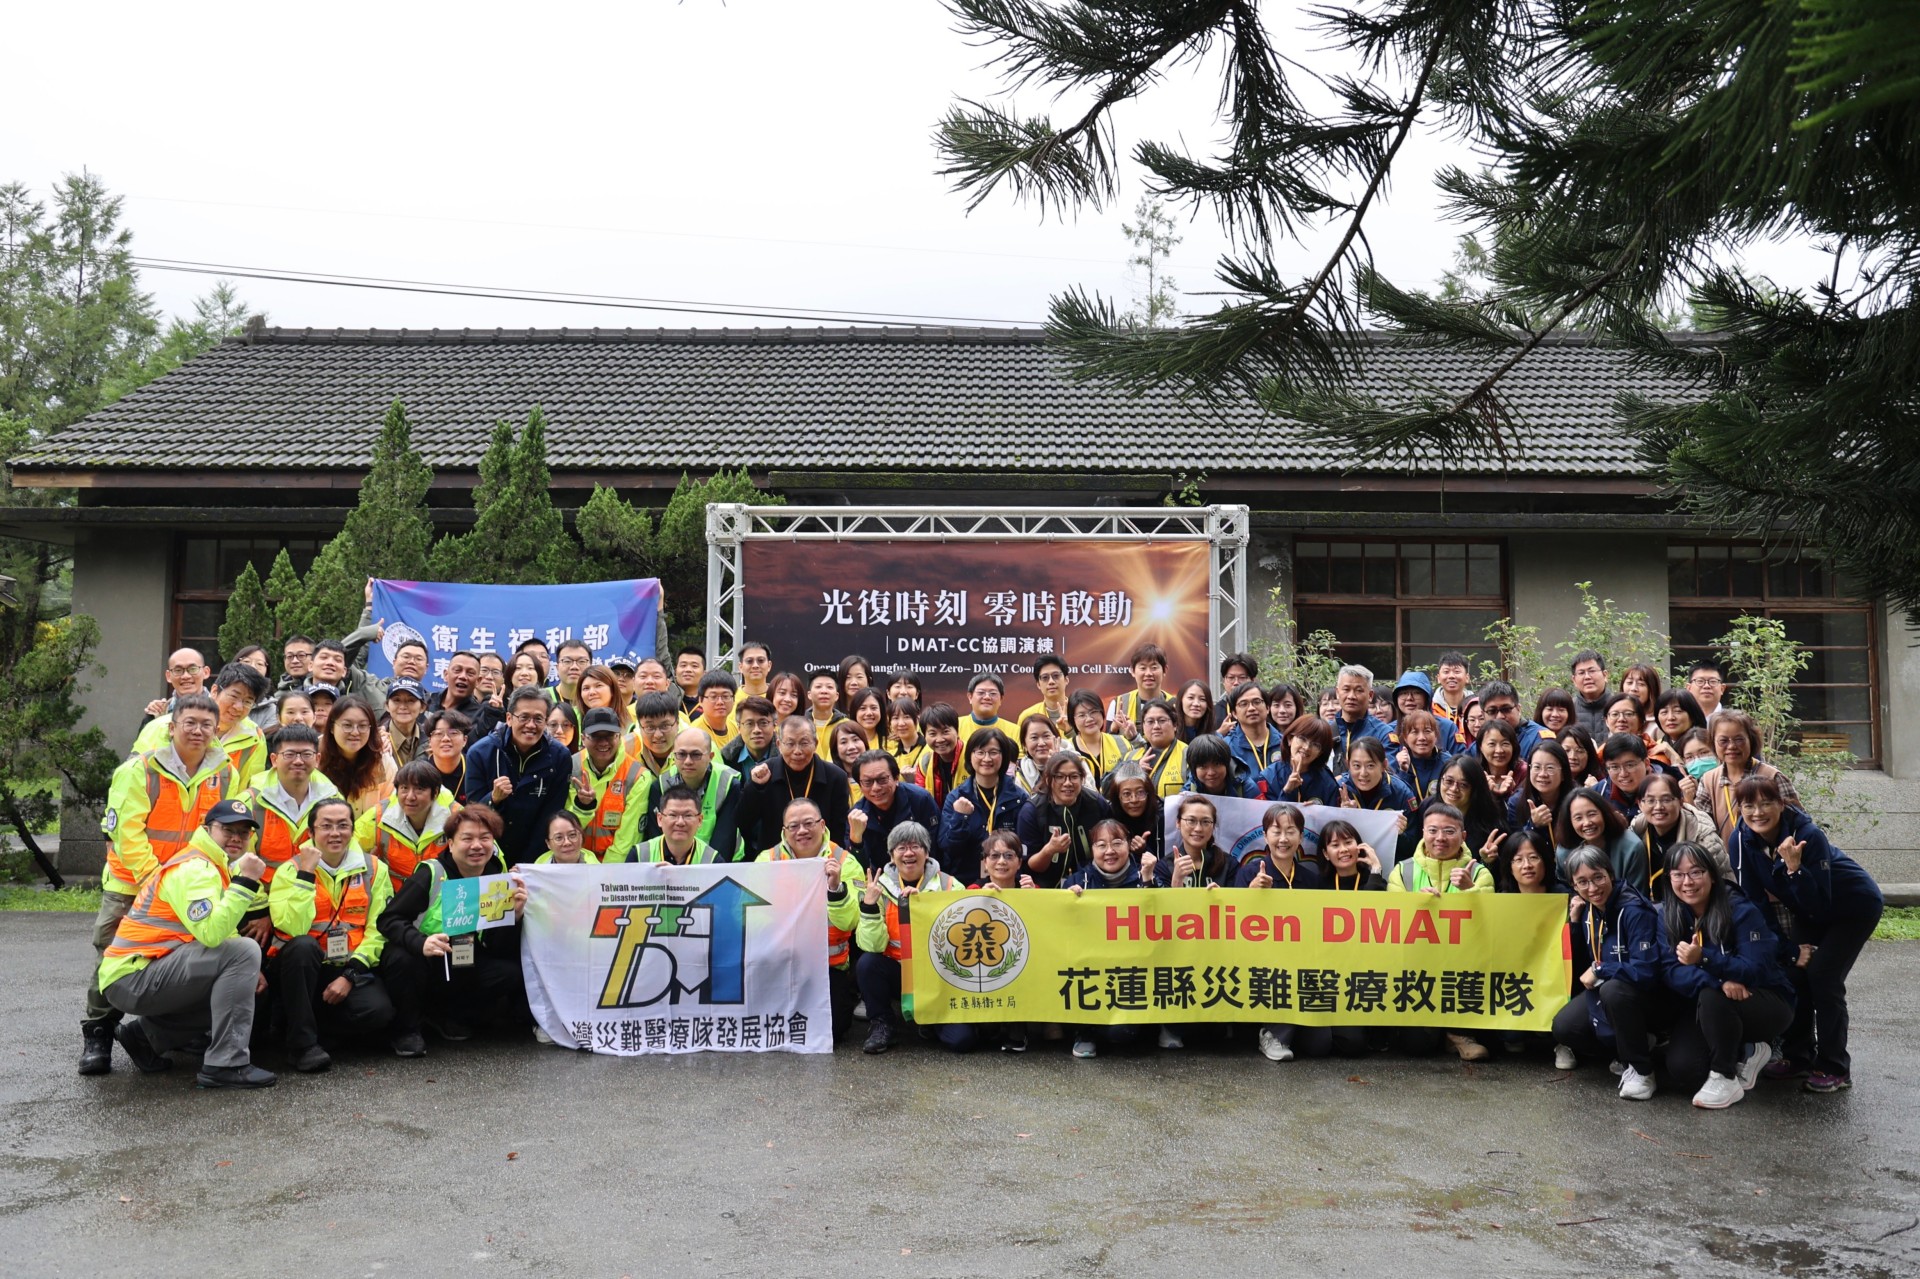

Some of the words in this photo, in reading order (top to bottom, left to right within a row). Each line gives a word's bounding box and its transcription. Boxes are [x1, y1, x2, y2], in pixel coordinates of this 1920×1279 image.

[819, 589, 967, 626] 光復時刻
[983, 590, 1132, 627] 零時啟動
[898, 637, 1054, 654] DMAT-CC協調演練
[804, 662, 840, 673] Operat
[910, 663, 937, 673] Hour
[973, 664, 1009, 673] DMAT
[1081, 664, 1102, 674] Cell
[600, 883, 629, 892] Taiwan
[631, 884, 666, 892] Development
[666, 884, 700, 892] Association
[610, 894, 637, 902] Disaster
[638, 893, 665, 902] Medical
[666, 894, 685, 902] Teams
[446, 914, 475, 928] EMOC
[1105, 905, 1302, 943] Hualien
[1321, 908, 1472, 944] DMAT
[1057, 965, 1535, 1017] 花蓮縣災難醫療救護隊
[949, 995, 1016, 1010] 花蓮縣衛生局
